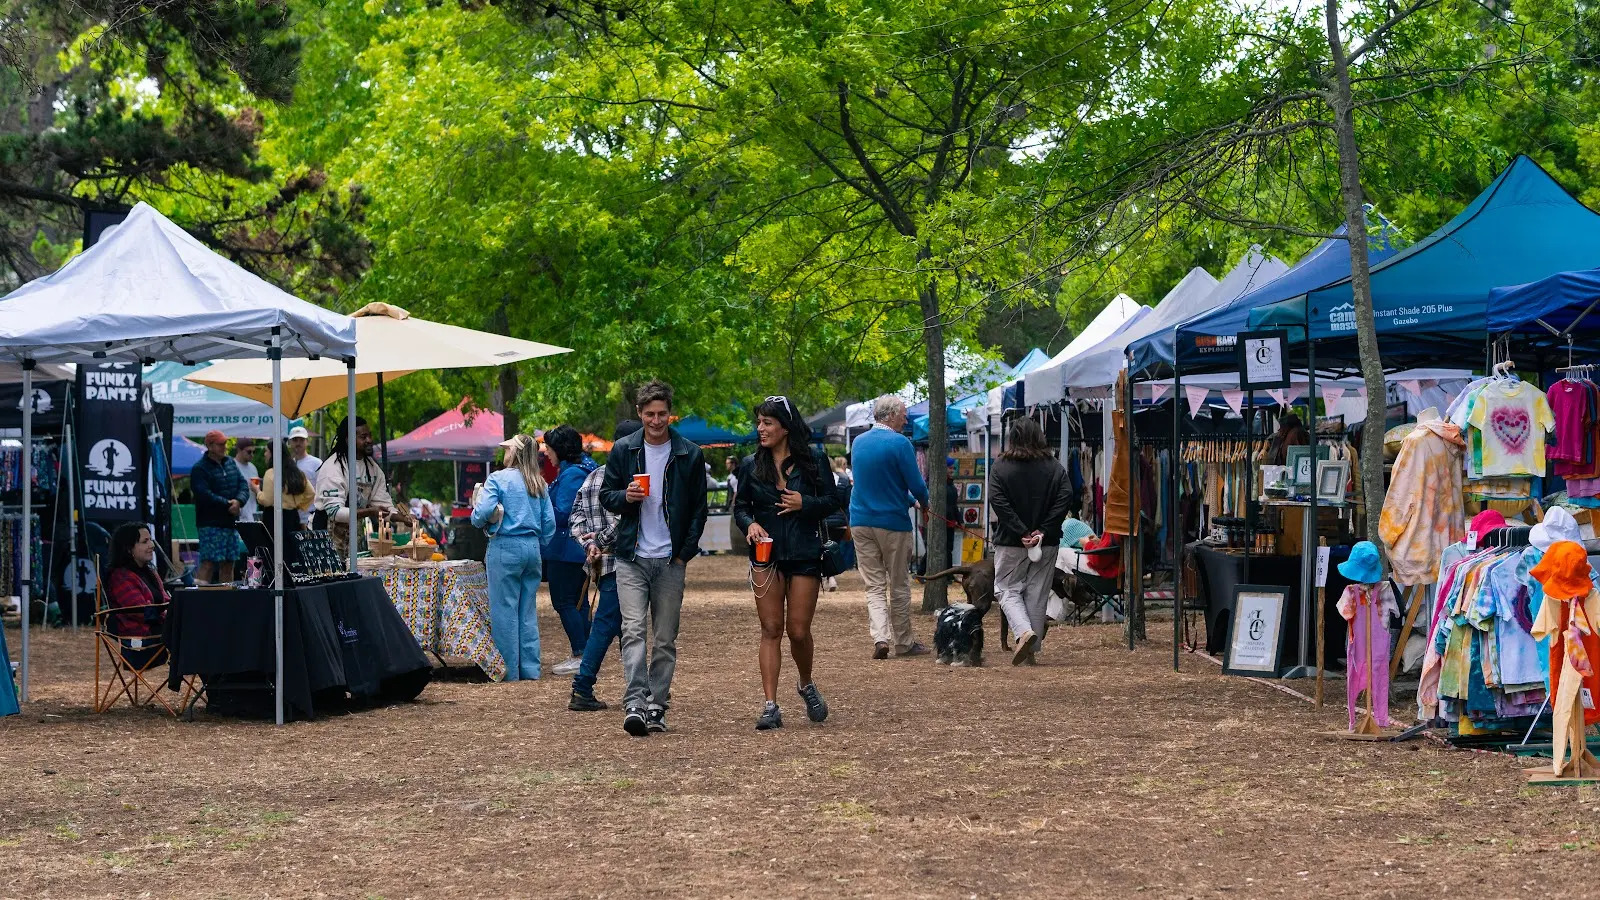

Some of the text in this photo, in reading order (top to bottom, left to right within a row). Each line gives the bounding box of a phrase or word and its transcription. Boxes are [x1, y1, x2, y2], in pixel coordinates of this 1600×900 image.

[1329, 311, 1356, 323] cam
[1373, 304, 1453, 318] Instant Shade 205 Plus
[1330, 321, 1358, 331] mast
[1393, 317, 1419, 326] Gazebo
[1199, 346, 1234, 354] EXPLORER
[85, 371, 138, 387] FUNKY
[85, 386, 138, 402] PANTS
[204, 415, 240, 424] TEARS
[241, 415, 256, 423] OF
[434, 421, 465, 436] activ
[84, 479, 137, 495] FUNKY
[84, 495, 137, 510] PANTS
